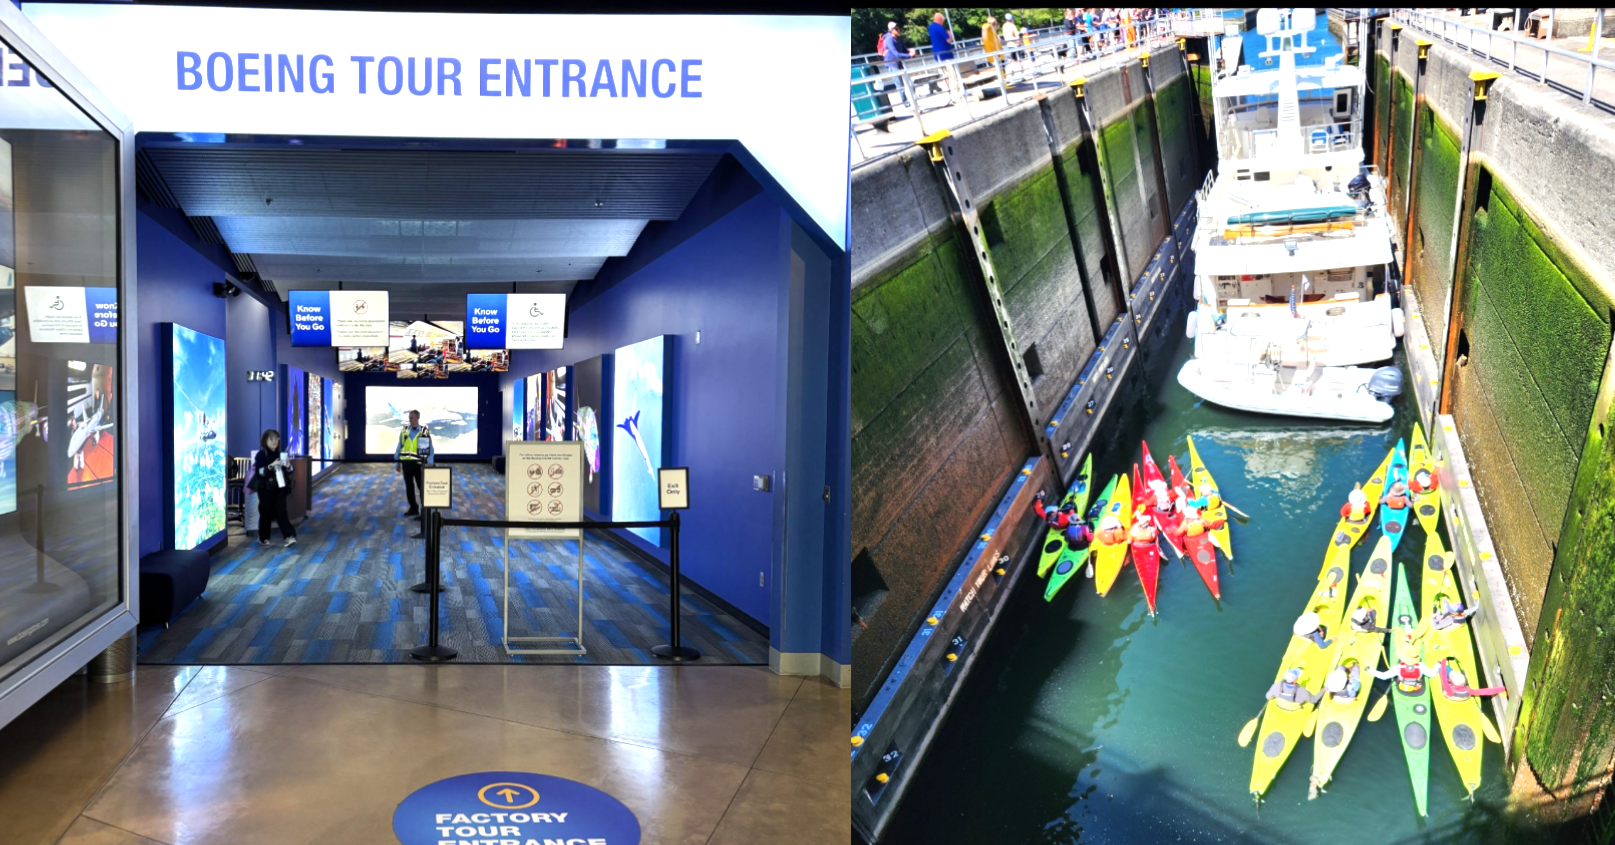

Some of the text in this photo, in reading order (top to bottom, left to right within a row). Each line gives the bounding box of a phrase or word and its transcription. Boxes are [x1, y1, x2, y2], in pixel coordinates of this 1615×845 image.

[177, 51, 702, 98] BOEING TOUR ENTRANCE
[296, 305, 321, 313] Know
[474, 307, 498, 316] Know
[295, 314, 324, 322] Before
[472, 316, 500, 325] Before
[295, 323, 325, 331] You Go
[998, 555, 1010, 565] 30
[951, 635, 963, 646] 31
[857, 723, 873, 736] 32
[882, 750, 899, 762] 32
[435, 813, 568, 823] FACTORY
[436, 826, 521, 837] TOUR
